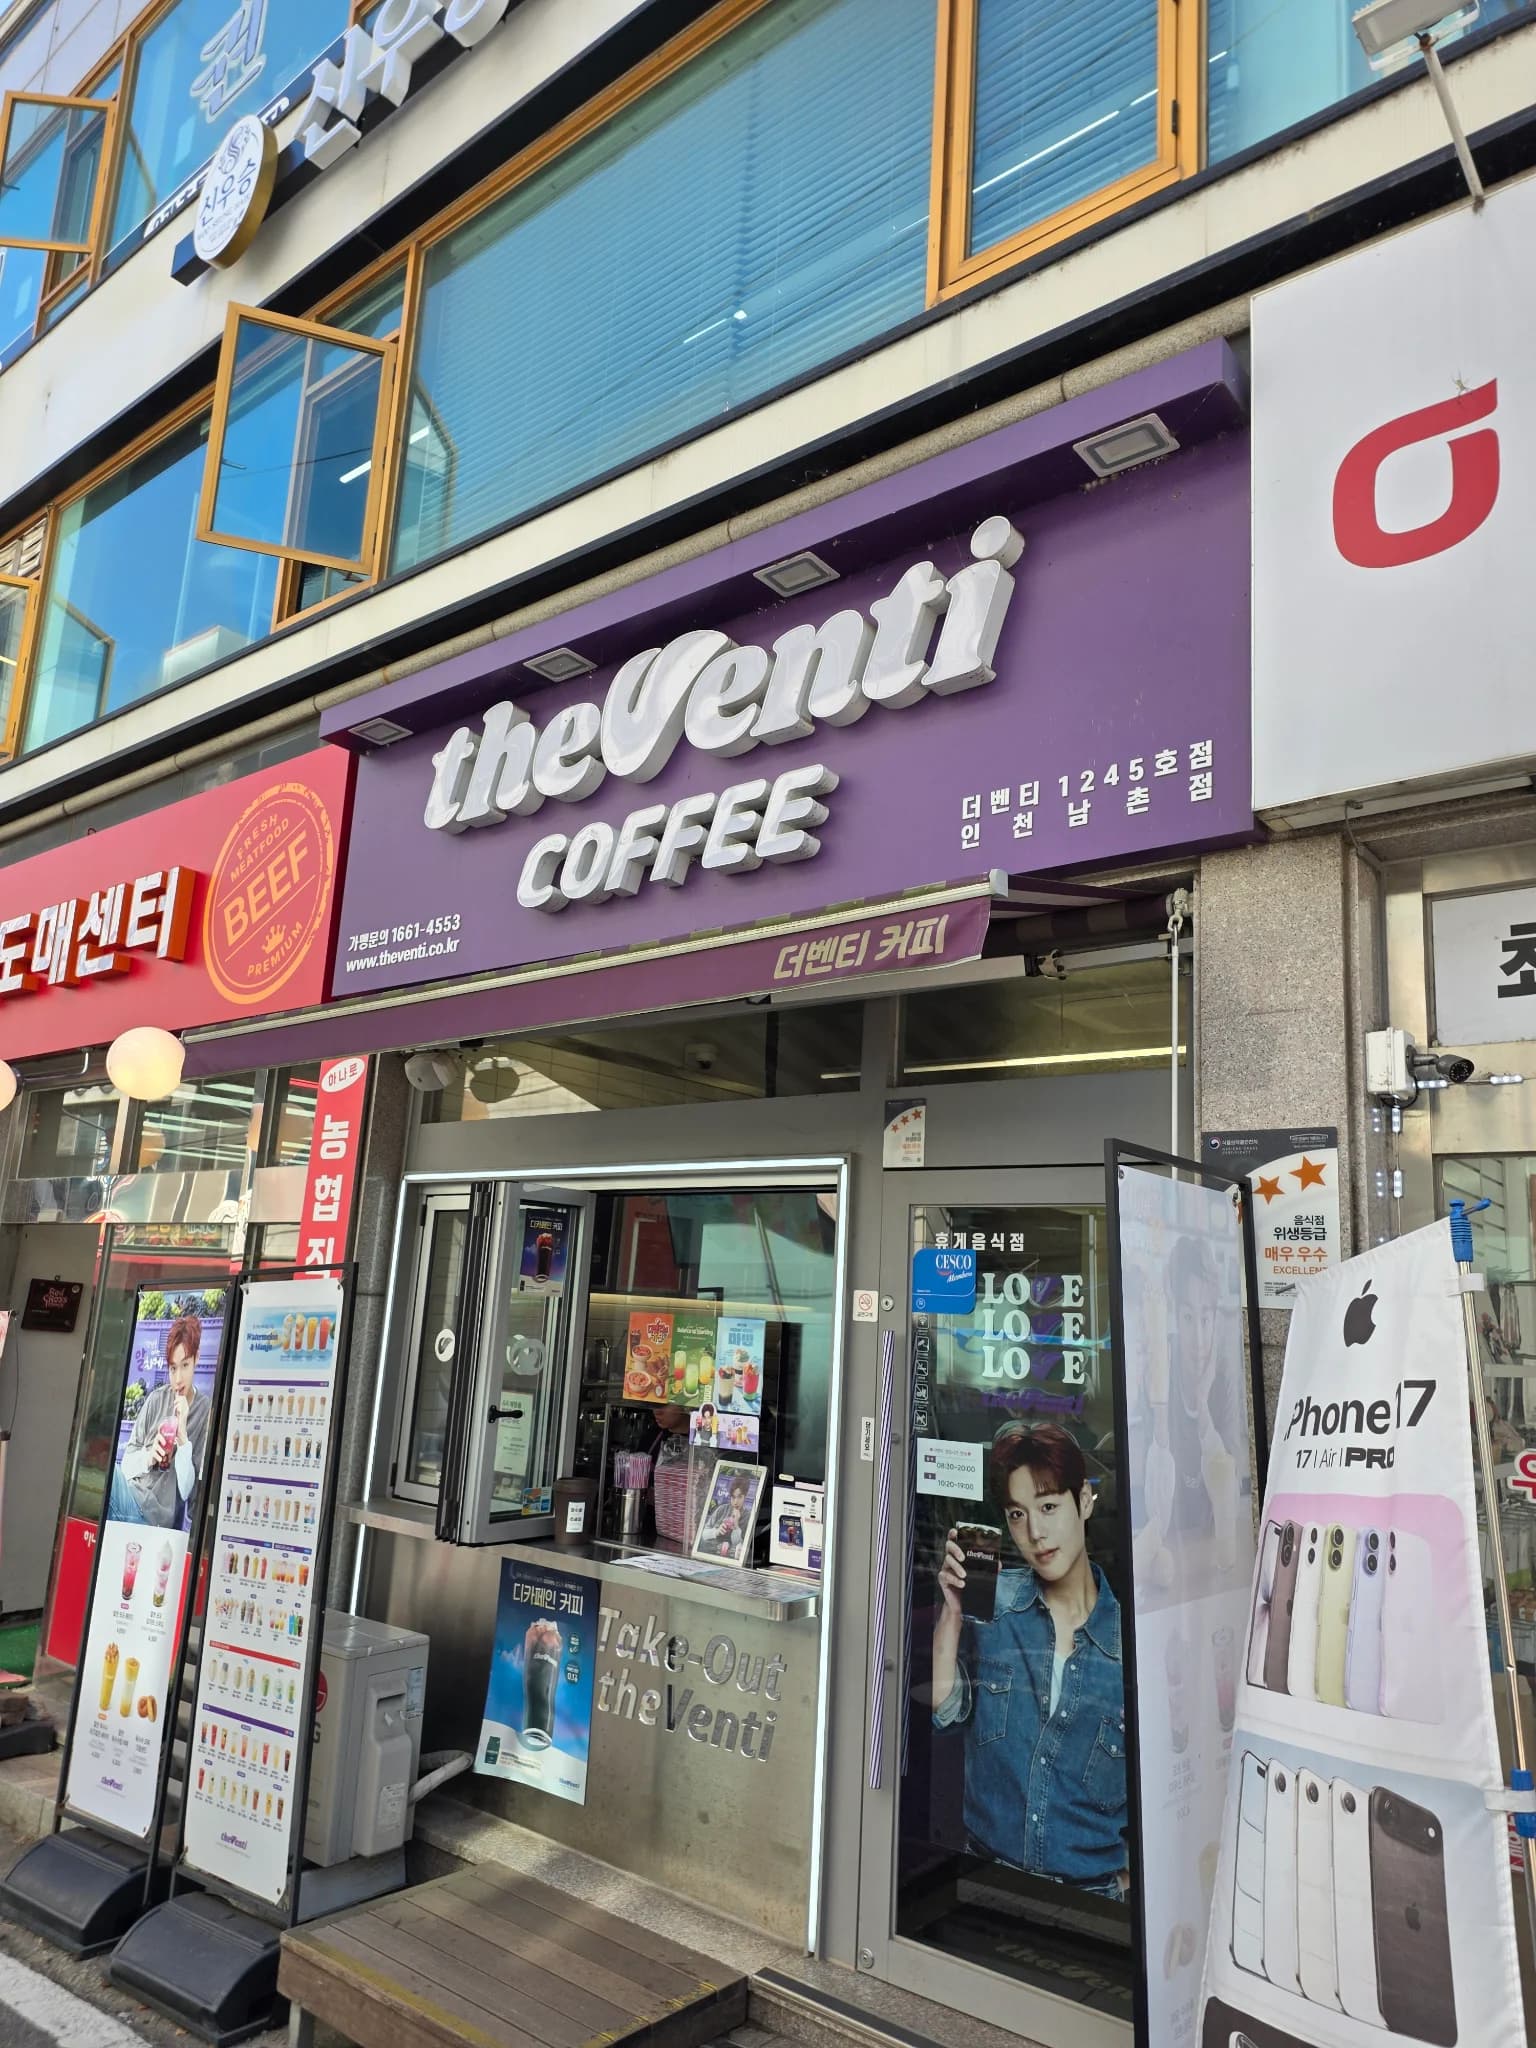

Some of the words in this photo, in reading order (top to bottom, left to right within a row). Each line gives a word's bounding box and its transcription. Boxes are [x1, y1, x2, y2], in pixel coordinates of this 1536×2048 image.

[199, 158, 258, 227] 신우승
[424, 515, 1026, 834] theVenti
[962, 781, 1040, 820] 더벤티
[1058, 740, 1213, 798] 1245호점
[230, 817, 290, 884] MEATFOOD
[237, 814, 279, 857] FRESH
[516, 764, 839, 912] COFFEE
[223, 829, 310, 947] BEEF
[247, 921, 304, 978] PREMIUM
[346, 937, 460, 973] www.theventi.co.kr
[348, 928, 390, 952] 가맹문의
[391, 913, 461, 943] 1661-4553
[773, 929, 871, 980] 더벤티
[874, 914, 950, 961] 커피
[935, 1231, 1025, 1252] 휴게음식점
[1273, 1226, 1328, 1241] 위생등급
[1293, 1214, 1326, 1226] 음식점
[935, 1254, 972, 1270] CESCO
[1264, 1246, 1295, 1263] 매우
[1297, 1247, 1329, 1263] 우수
[1296, 1450, 1312, 1469] 17
[1319, 1448, 1336, 1468] Air
[512, 1583, 557, 1611] 디카페인
[559, 1592, 584, 1617] 커피
[598, 1606, 787, 1700] Take-Out
[598, 1668, 778, 1762] theVenti
